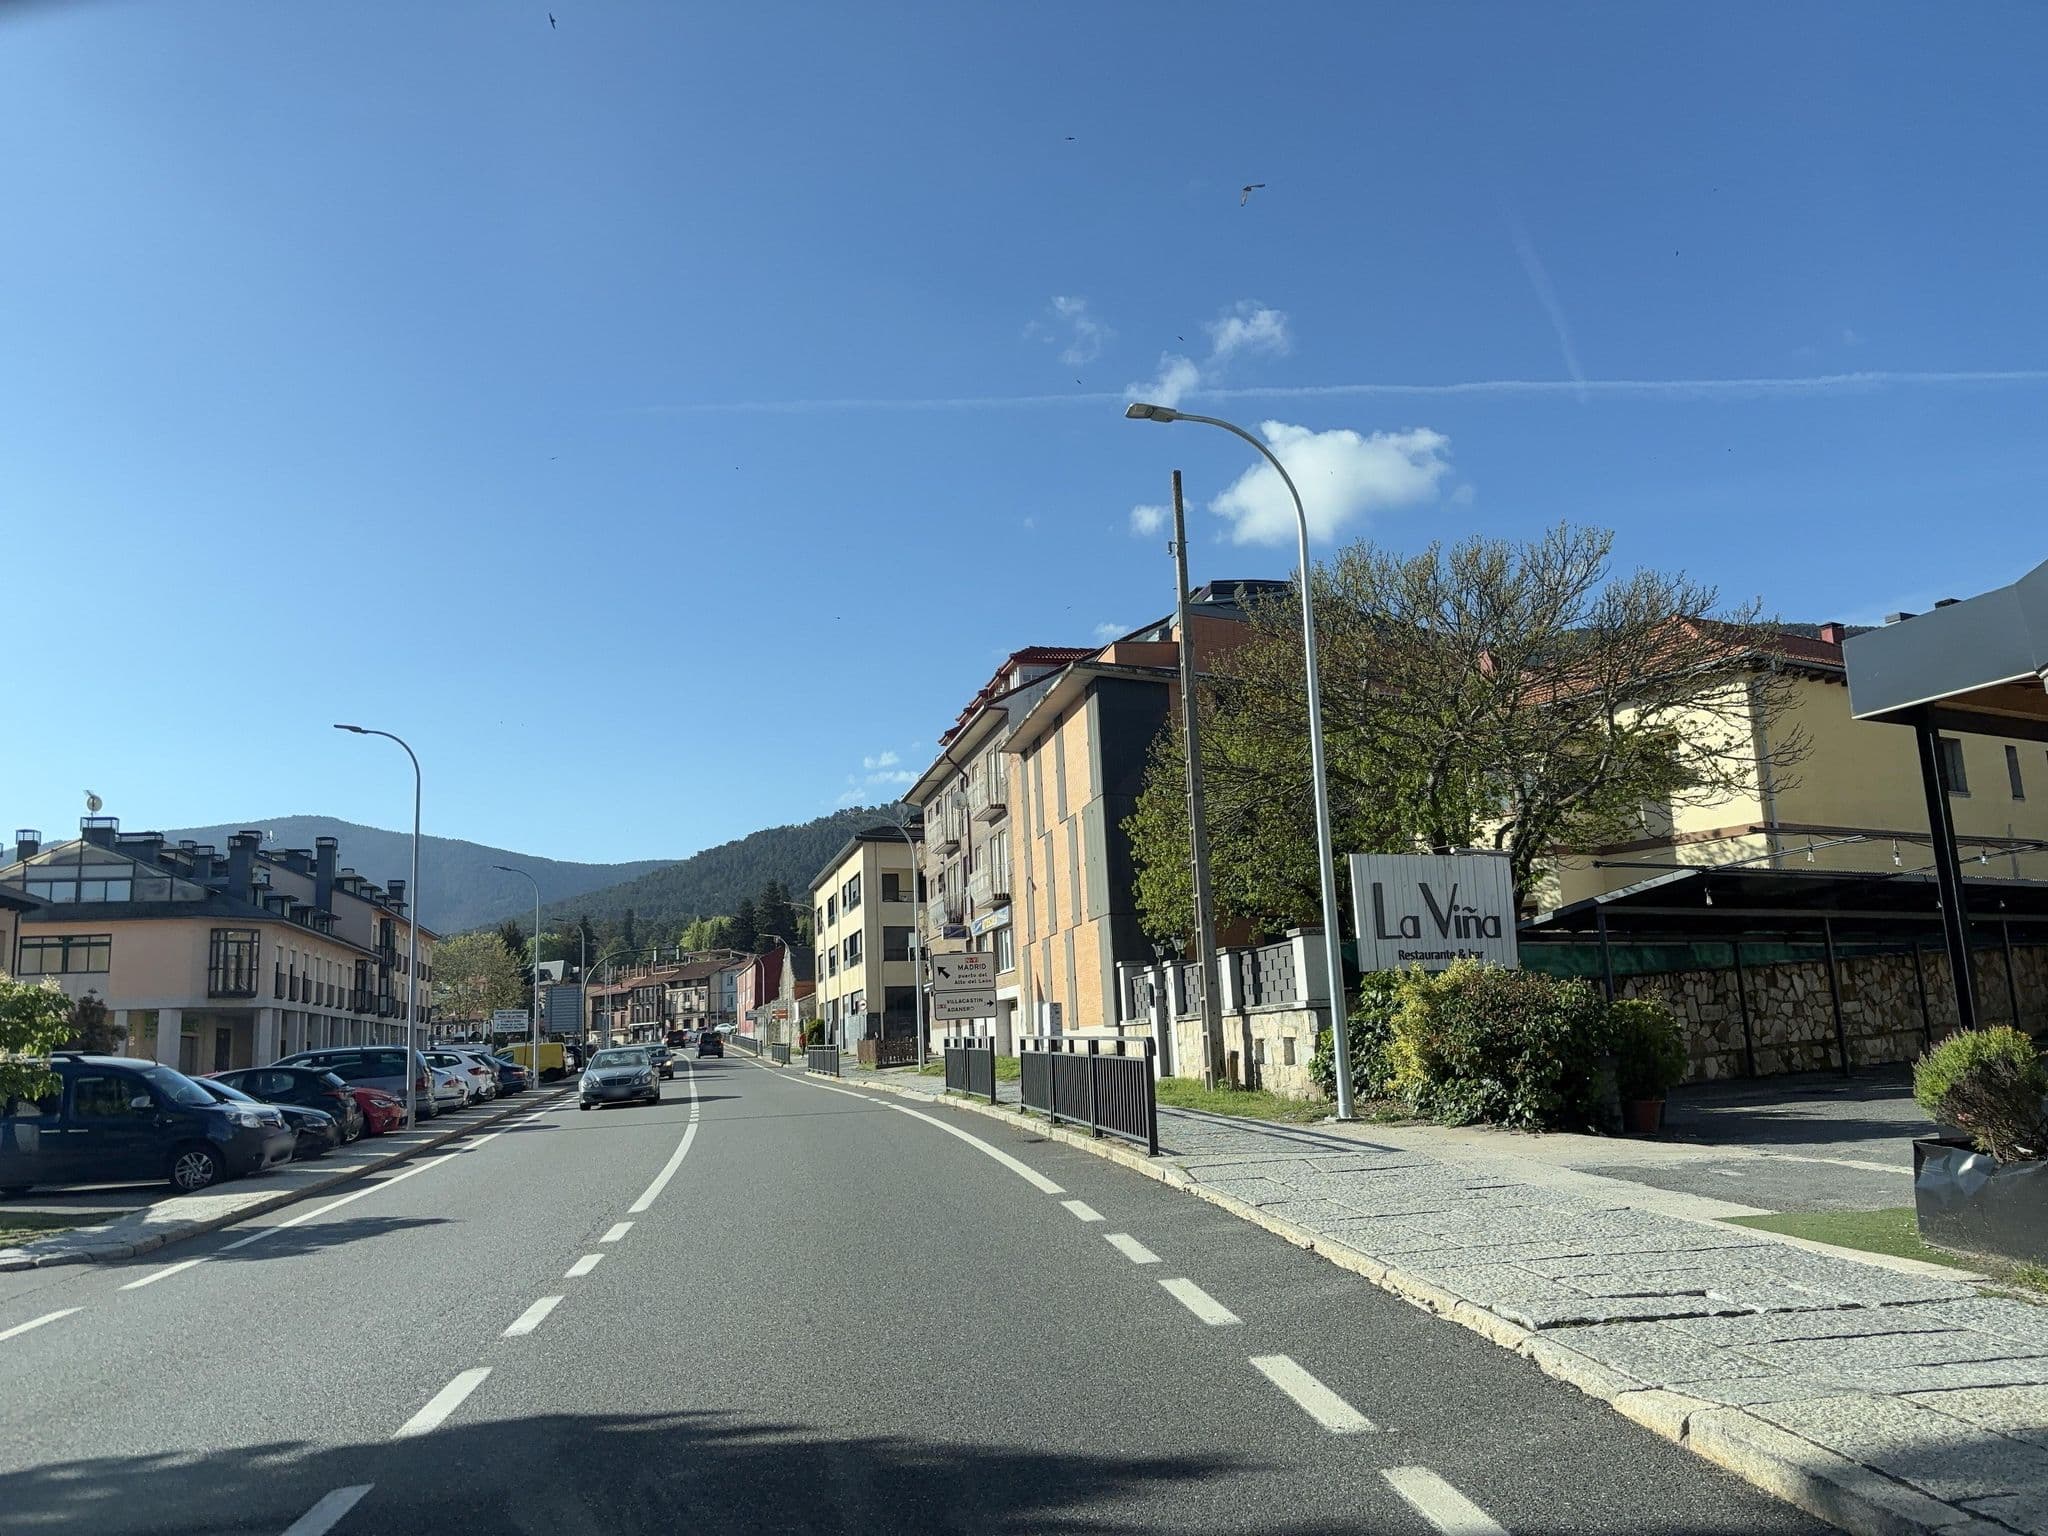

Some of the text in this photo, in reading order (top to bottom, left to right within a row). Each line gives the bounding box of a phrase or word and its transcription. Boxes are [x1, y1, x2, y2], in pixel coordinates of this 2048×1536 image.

[1373, 882, 1502, 939] La Viña
[1398, 948, 1484, 960] Restaurante & bar
